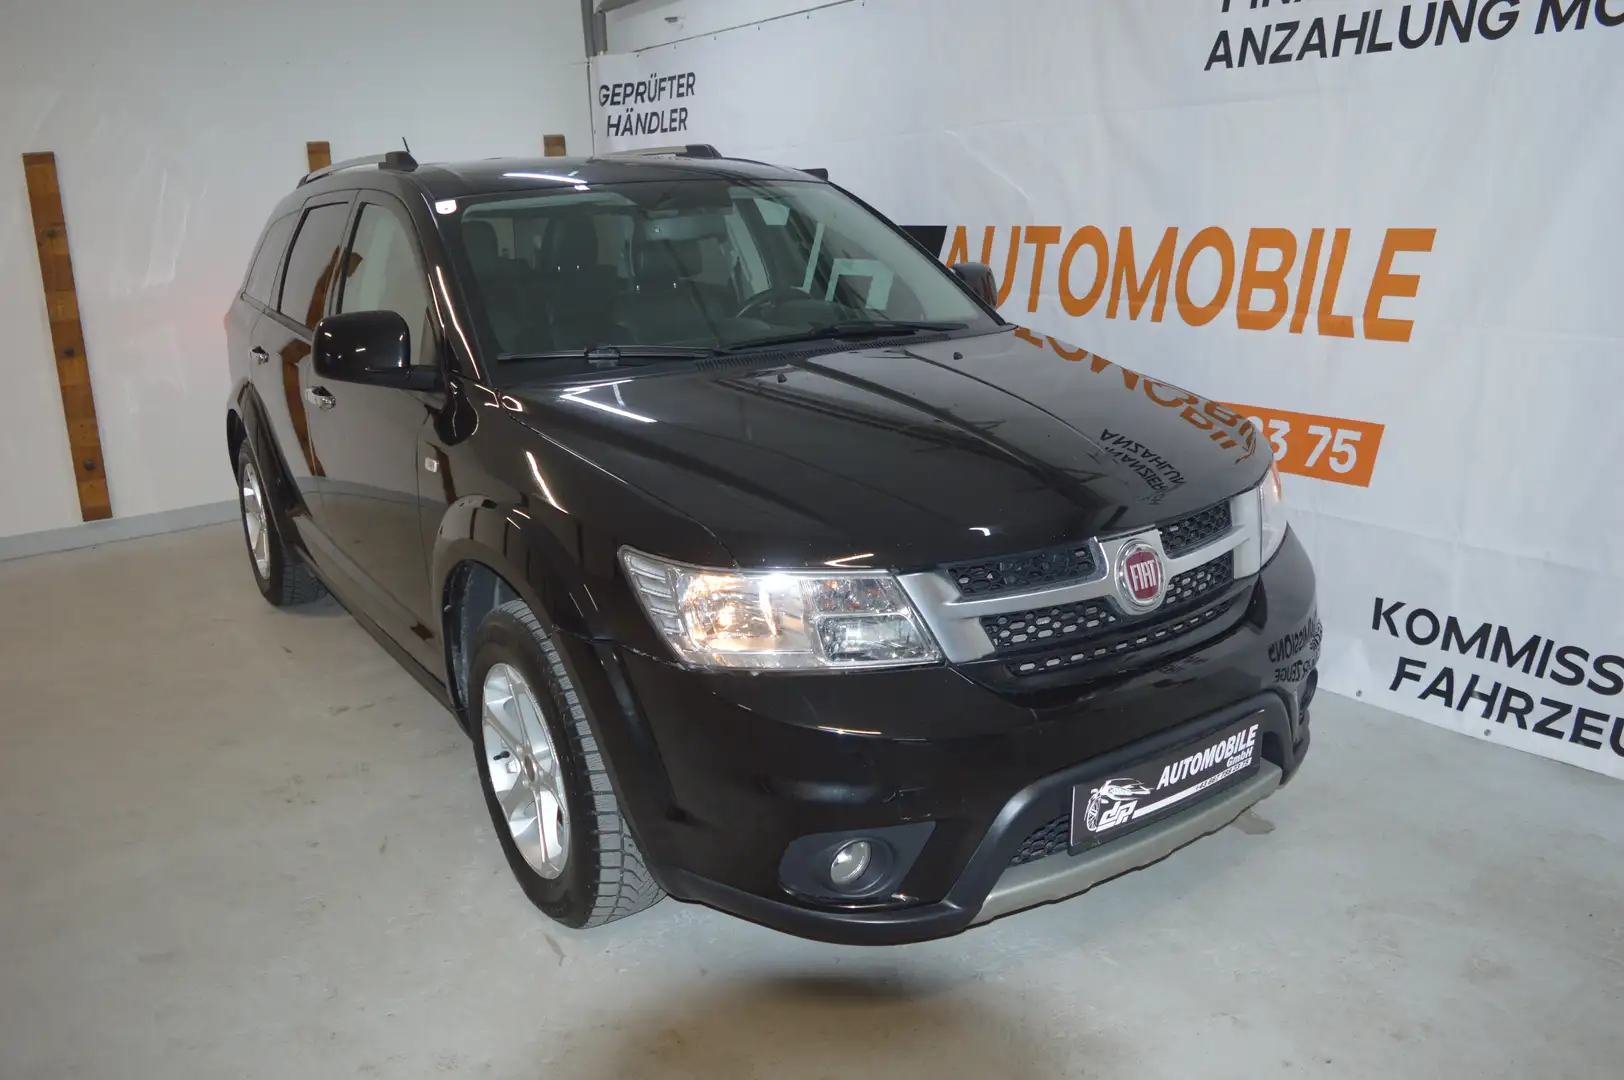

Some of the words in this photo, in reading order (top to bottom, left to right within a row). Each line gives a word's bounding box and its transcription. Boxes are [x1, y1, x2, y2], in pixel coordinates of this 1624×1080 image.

[1204, 0, 1520, 71] ANZAHLUNG
[599, 72, 696, 106] GEPRÜFTER
[607, 107, 688, 137] HÄNDLER
[946, 226, 1437, 342] AUTOMOBILE
[1304, 425, 1362, 474] 75
[1130, 560, 1157, 591] FIAT
[1157, 724, 1259, 790] AUTOMOBILE
[1226, 746, 1253, 768] GmbH
